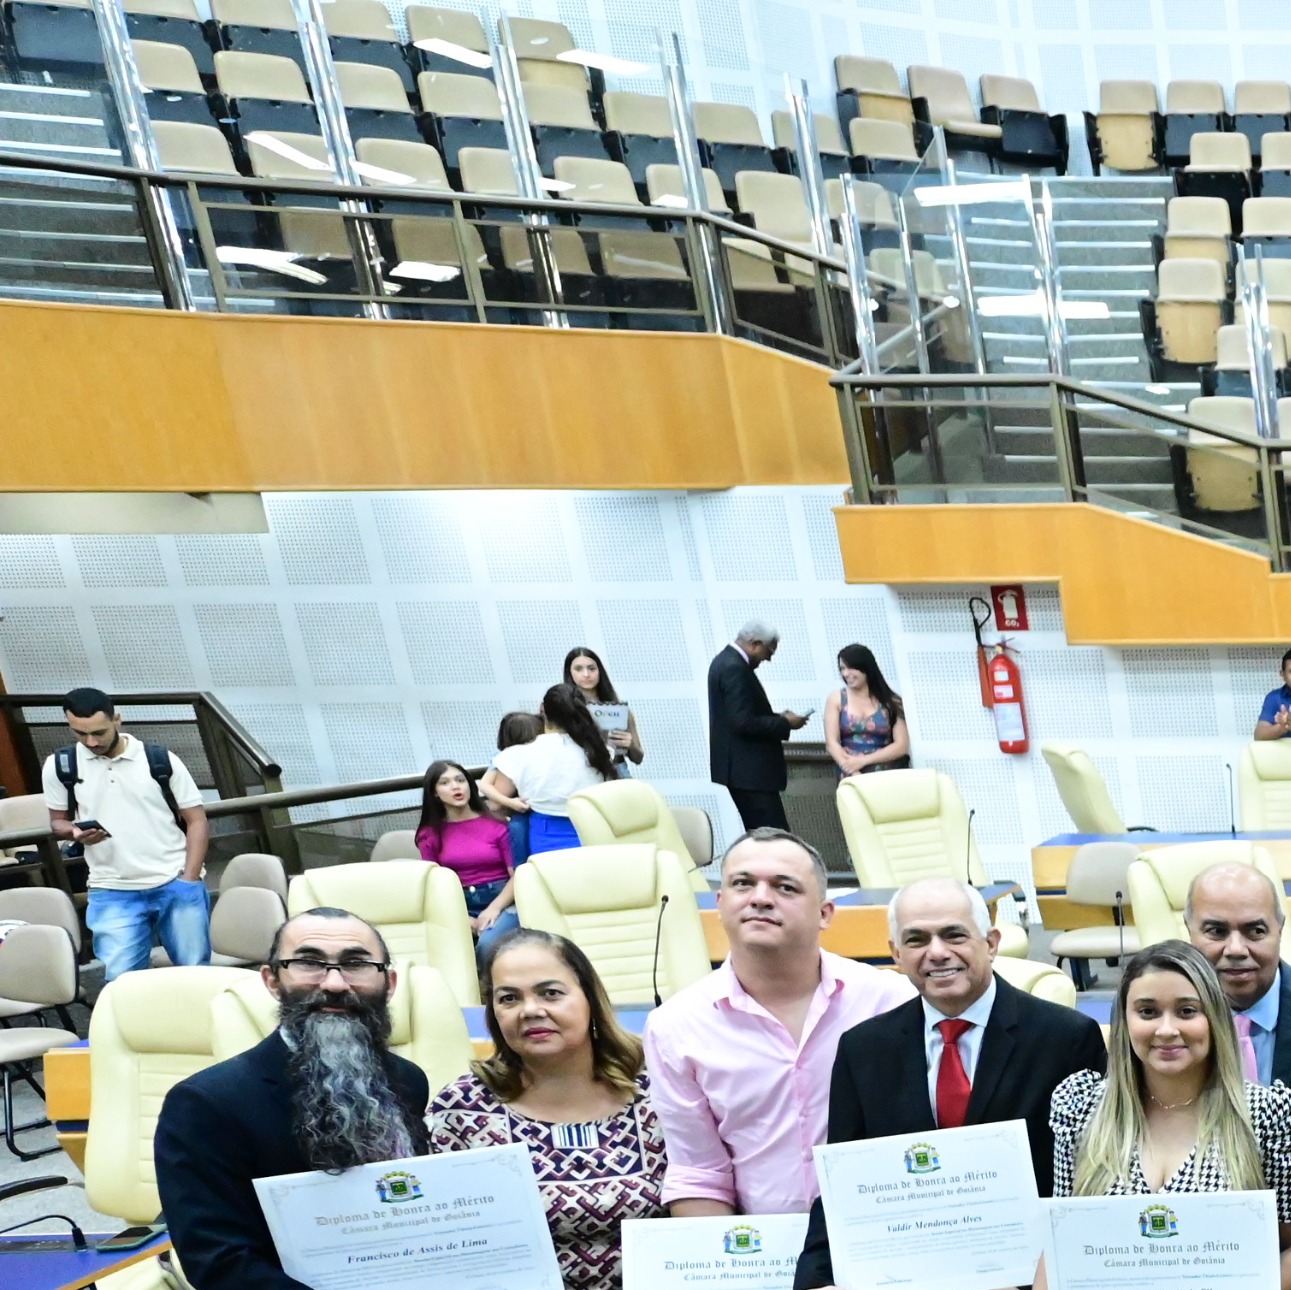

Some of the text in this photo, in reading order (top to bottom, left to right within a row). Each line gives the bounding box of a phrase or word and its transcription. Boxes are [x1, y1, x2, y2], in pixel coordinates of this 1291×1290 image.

[857, 1183, 898, 1193] Diploma
[915, 1178, 946, 1187] Honra
[965, 1171, 997, 1182] Mérito
[314, 1214, 369, 1226] Diploma
[391, 1203, 431, 1217] Honra
[453, 1196, 494, 1209] Mérito
[887, 1224, 912, 1232] Valdir
[915, 1219, 958, 1229] Mendonça
[347, 1252, 400, 1264] Francisco
[419, 1245, 444, 1253] Assis
[1083, 1245, 1129, 1256] Diploma
[1133, 1245, 1144, 1253] de
[1149, 1243, 1183, 1253] Honra
[1203, 1241, 1239, 1252] Mérito
[665, 1261, 710, 1270] Diploma
[732, 1259, 765, 1267] Honra
